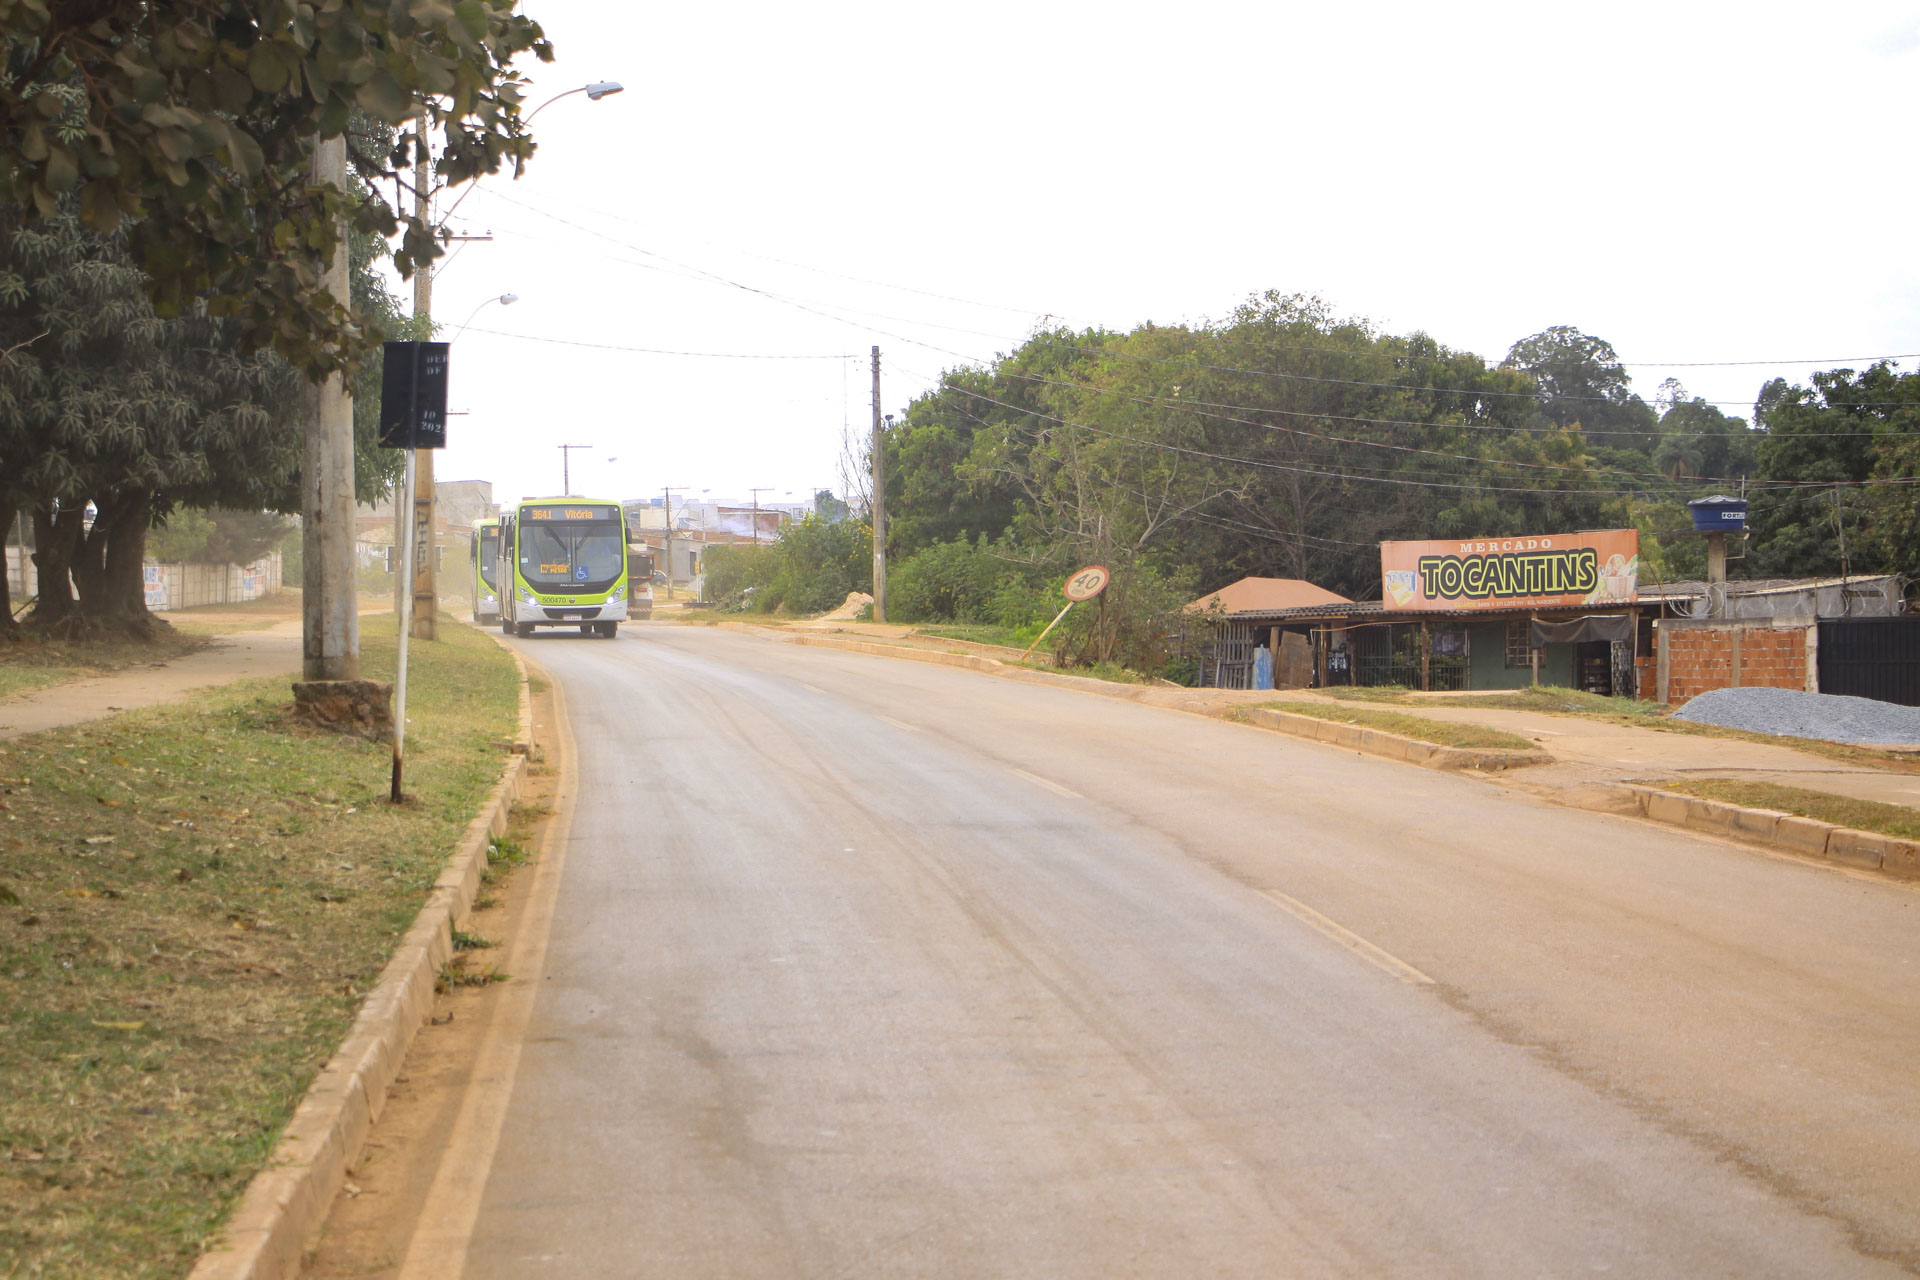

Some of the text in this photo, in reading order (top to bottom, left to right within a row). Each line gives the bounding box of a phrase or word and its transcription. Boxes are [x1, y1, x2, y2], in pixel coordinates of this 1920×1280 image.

[564, 510, 593, 519] Vitória
[1460, 538, 1552, 552] MERCADO
[1420, 551, 1596, 597] TOCANTINS
[1074, 574, 1100, 590] 40
